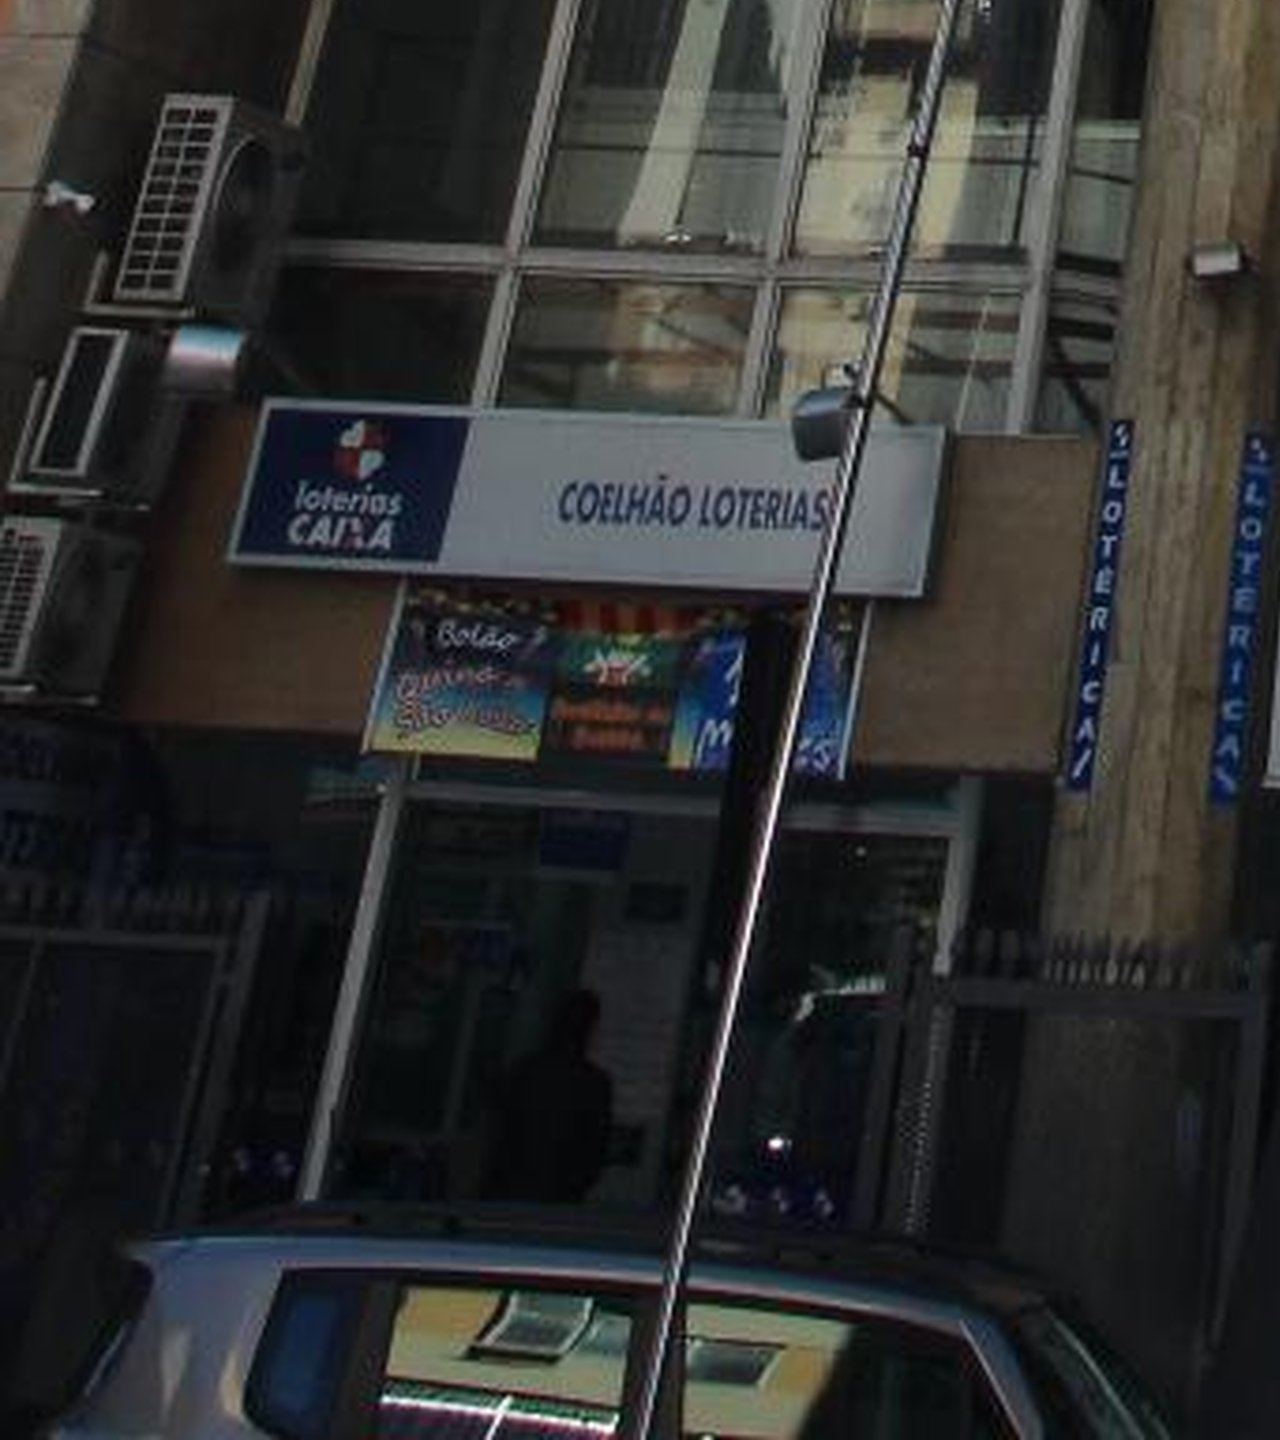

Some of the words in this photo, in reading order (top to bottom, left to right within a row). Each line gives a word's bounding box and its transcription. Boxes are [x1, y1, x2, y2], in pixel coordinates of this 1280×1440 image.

[293, 481, 403, 515] loterias
[558, 475, 690, 528] COELHÃO
[698, 483, 829, 534] LOTERIAS
[285, 513, 394, 552] CAIXA
